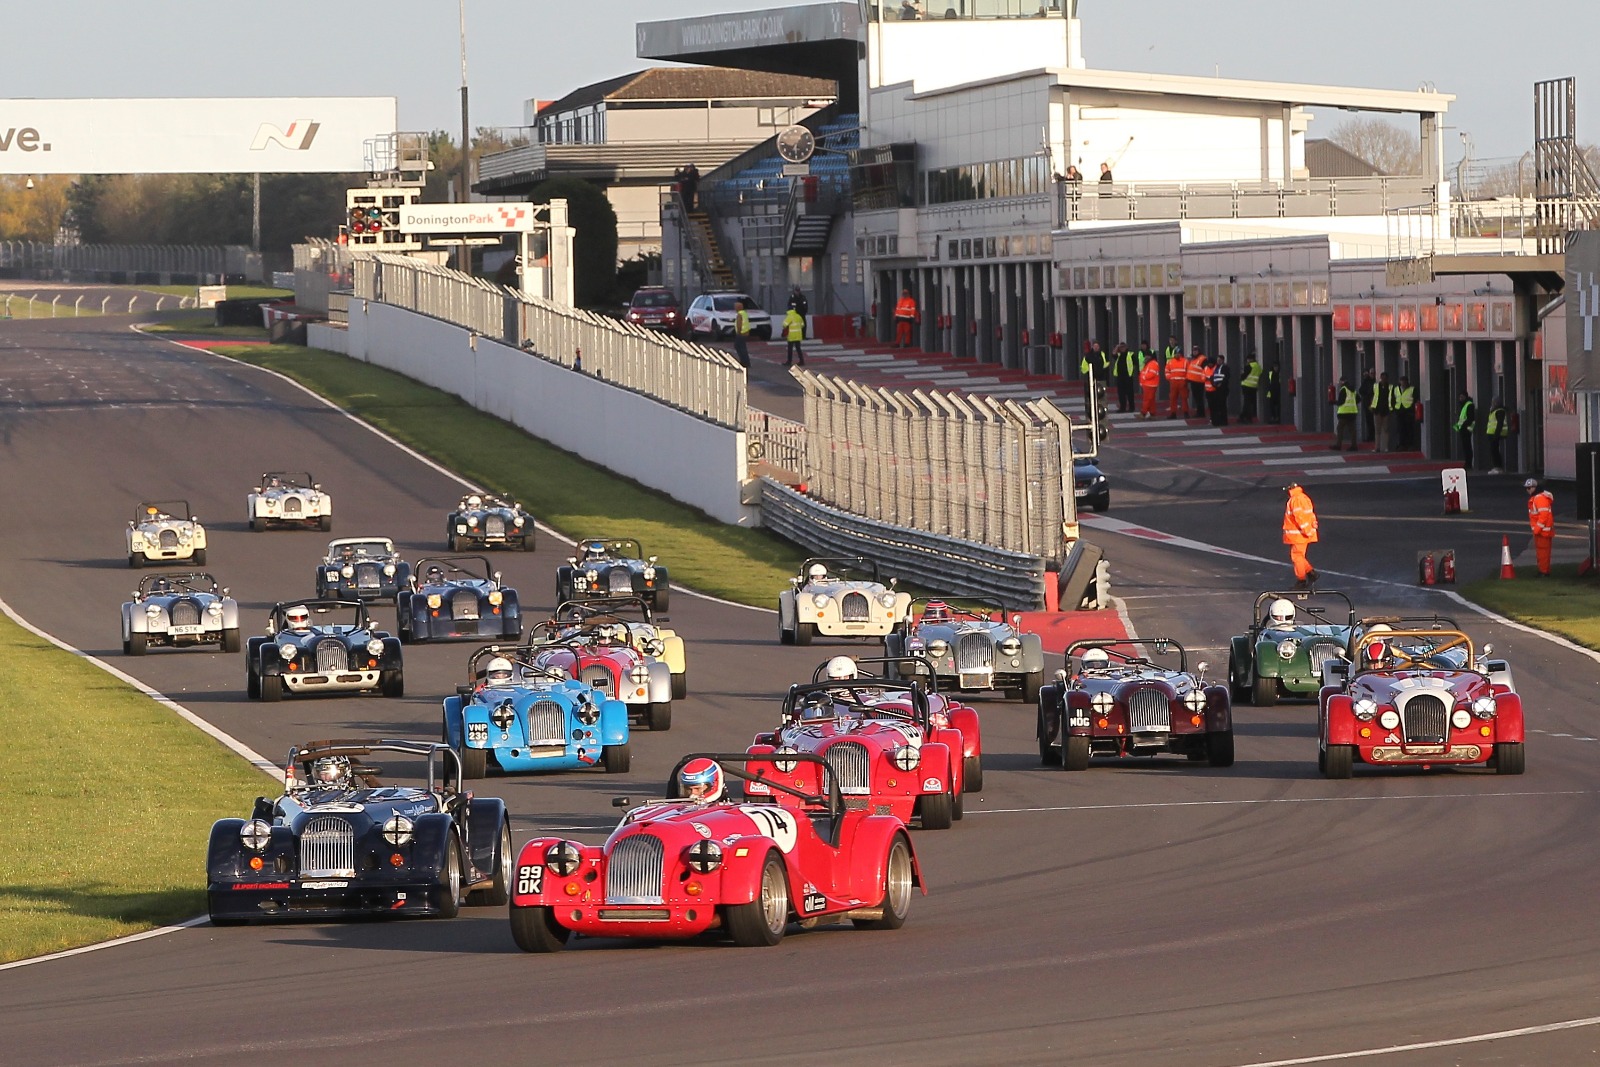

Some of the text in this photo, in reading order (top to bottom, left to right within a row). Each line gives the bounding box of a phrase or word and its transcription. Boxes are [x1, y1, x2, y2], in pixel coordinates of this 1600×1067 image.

[682, 16, 784, 47] WWW.DONINGTON-PARK.CO.UK
[407, 214, 494, 226] DoningtonPark
[468, 723, 488, 732] VNP
[749, 809, 787, 837] 74
[520, 866, 542, 879] 99
[519, 880, 541, 894] OK
